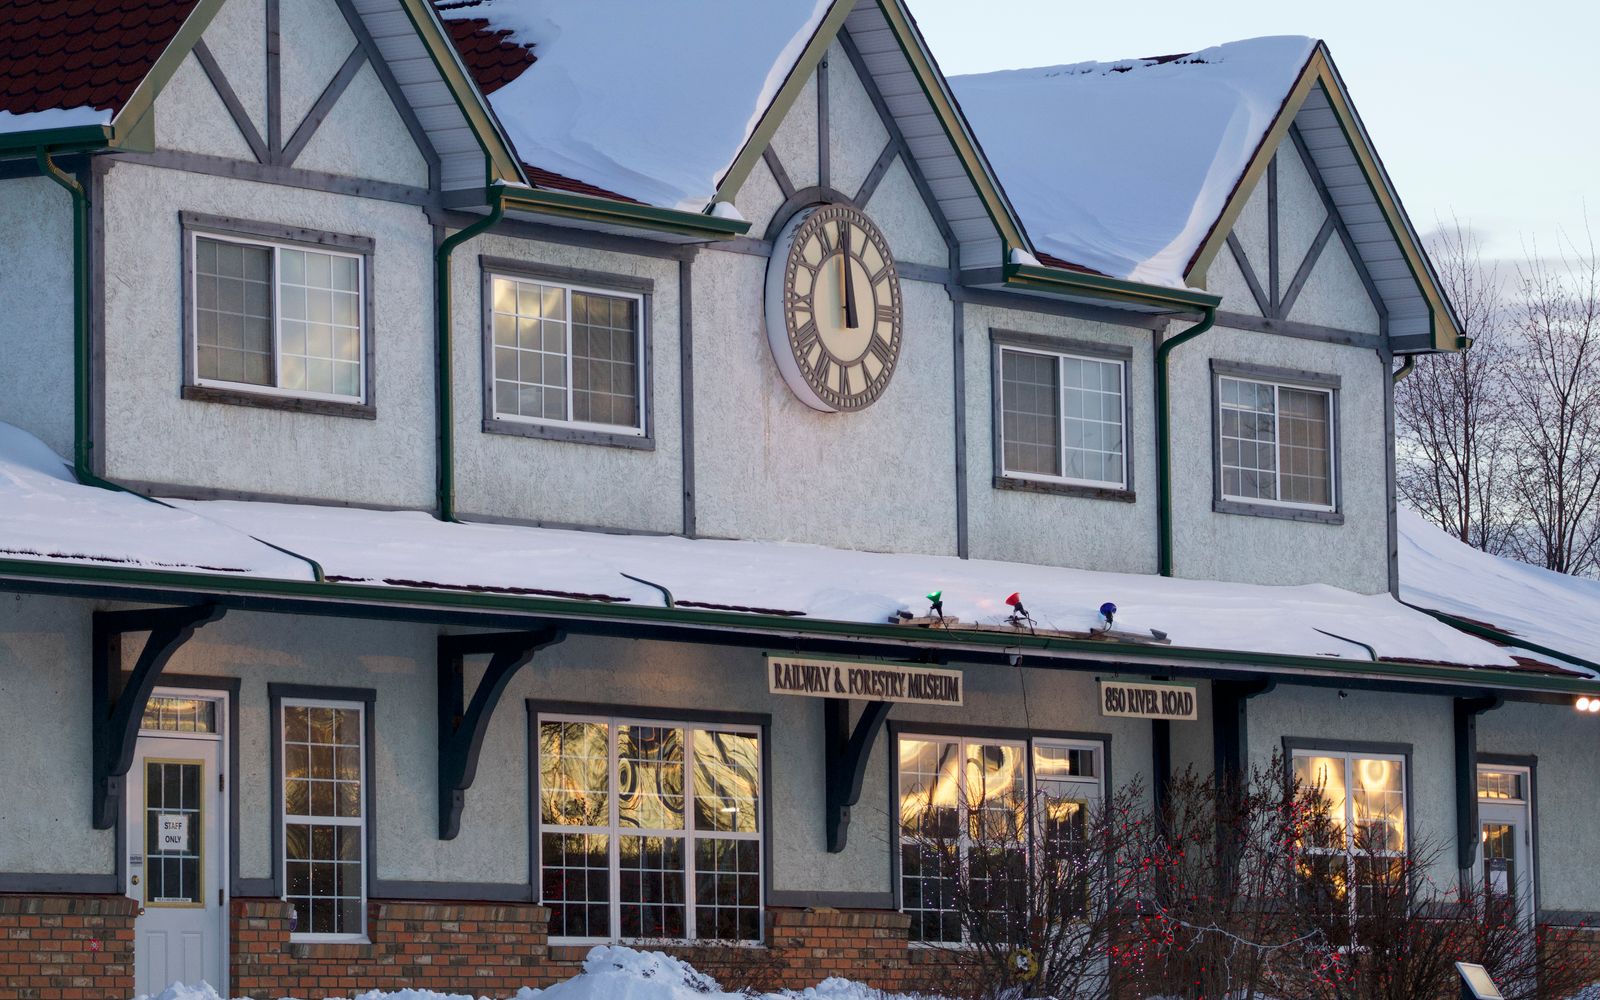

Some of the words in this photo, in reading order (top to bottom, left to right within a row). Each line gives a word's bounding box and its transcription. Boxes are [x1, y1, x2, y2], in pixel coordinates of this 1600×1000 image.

[814, 225, 832, 258] XI
[798, 254, 817, 279] X
[872, 265, 890, 287] II
[793, 292, 812, 313] IX
[877, 305, 893, 322] III
[839, 365, 852, 395] VI
[861, 360, 875, 388] V
[773, 663, 831, 693] RAILWAY
[833, 667, 847, 694] &
[848, 668, 906, 698] FORESTRY
[907, 673, 960, 702] MUSEUM
[1105, 686, 1126, 712] 850
[1127, 688, 1160, 714] RIVER
[1161, 690, 1193, 716] ROAD
[164, 821, 182, 830] STAFF
[165, 835, 182, 843] ONLY
